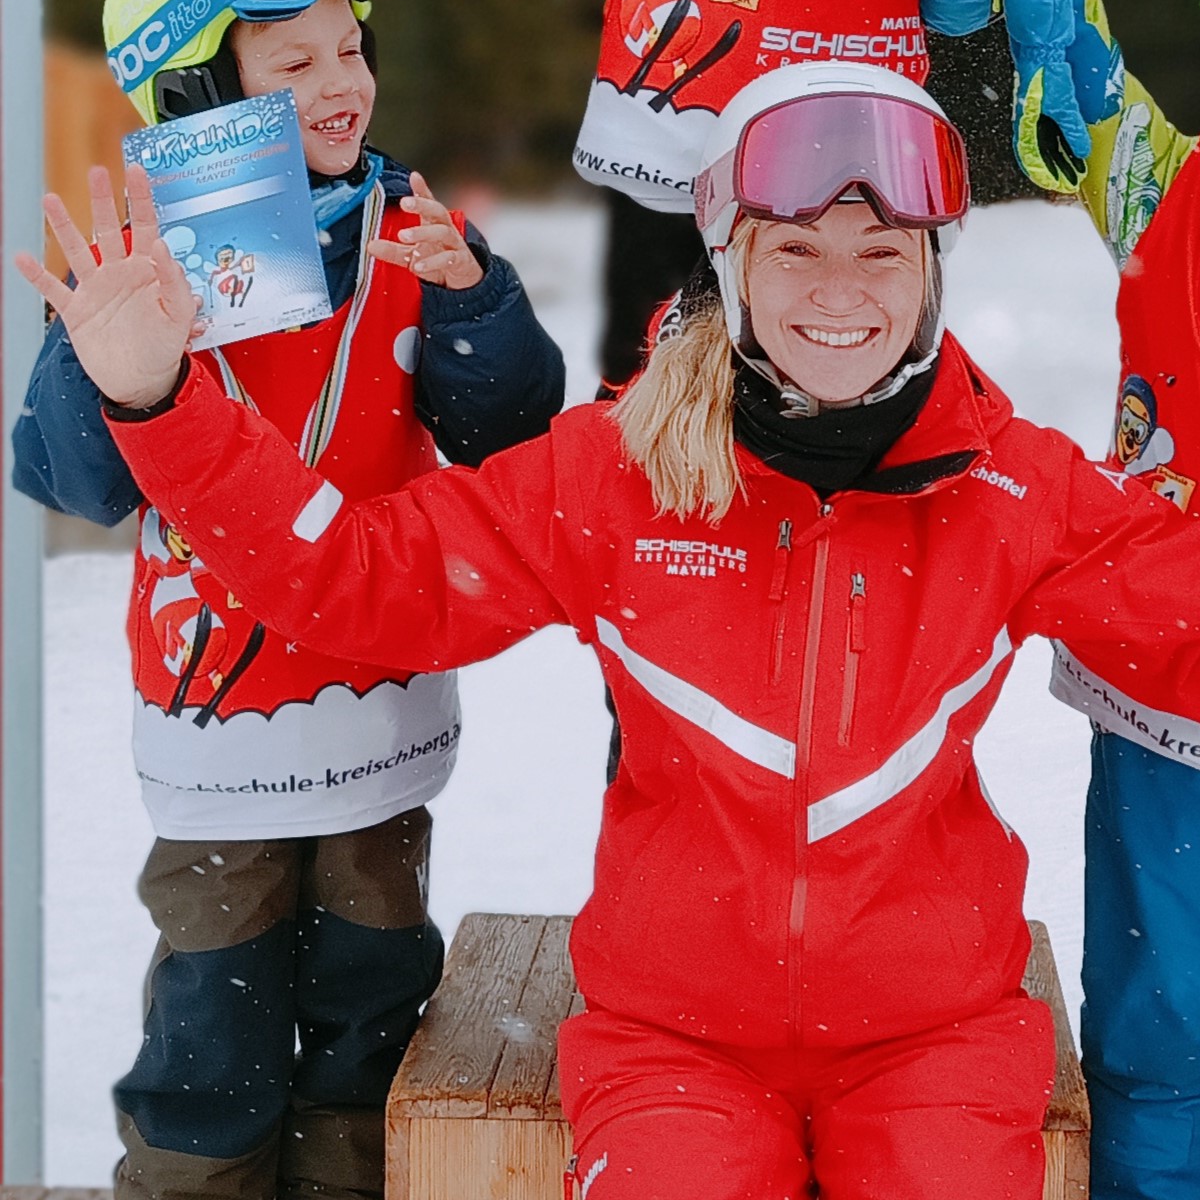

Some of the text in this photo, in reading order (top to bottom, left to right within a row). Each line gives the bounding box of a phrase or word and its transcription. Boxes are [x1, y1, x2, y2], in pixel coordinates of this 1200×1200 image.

[760, 26, 928, 58] SCHISCHUL
[140, 110, 284, 170] URKUNDE
[195, 167, 237, 185] MAYER
[969, 466, 1028, 501] chöffel
[635, 538, 748, 562] SCHISCHULE
[634, 552, 747, 573] KREISCHBERG
[666, 563, 717, 578] MAYER
